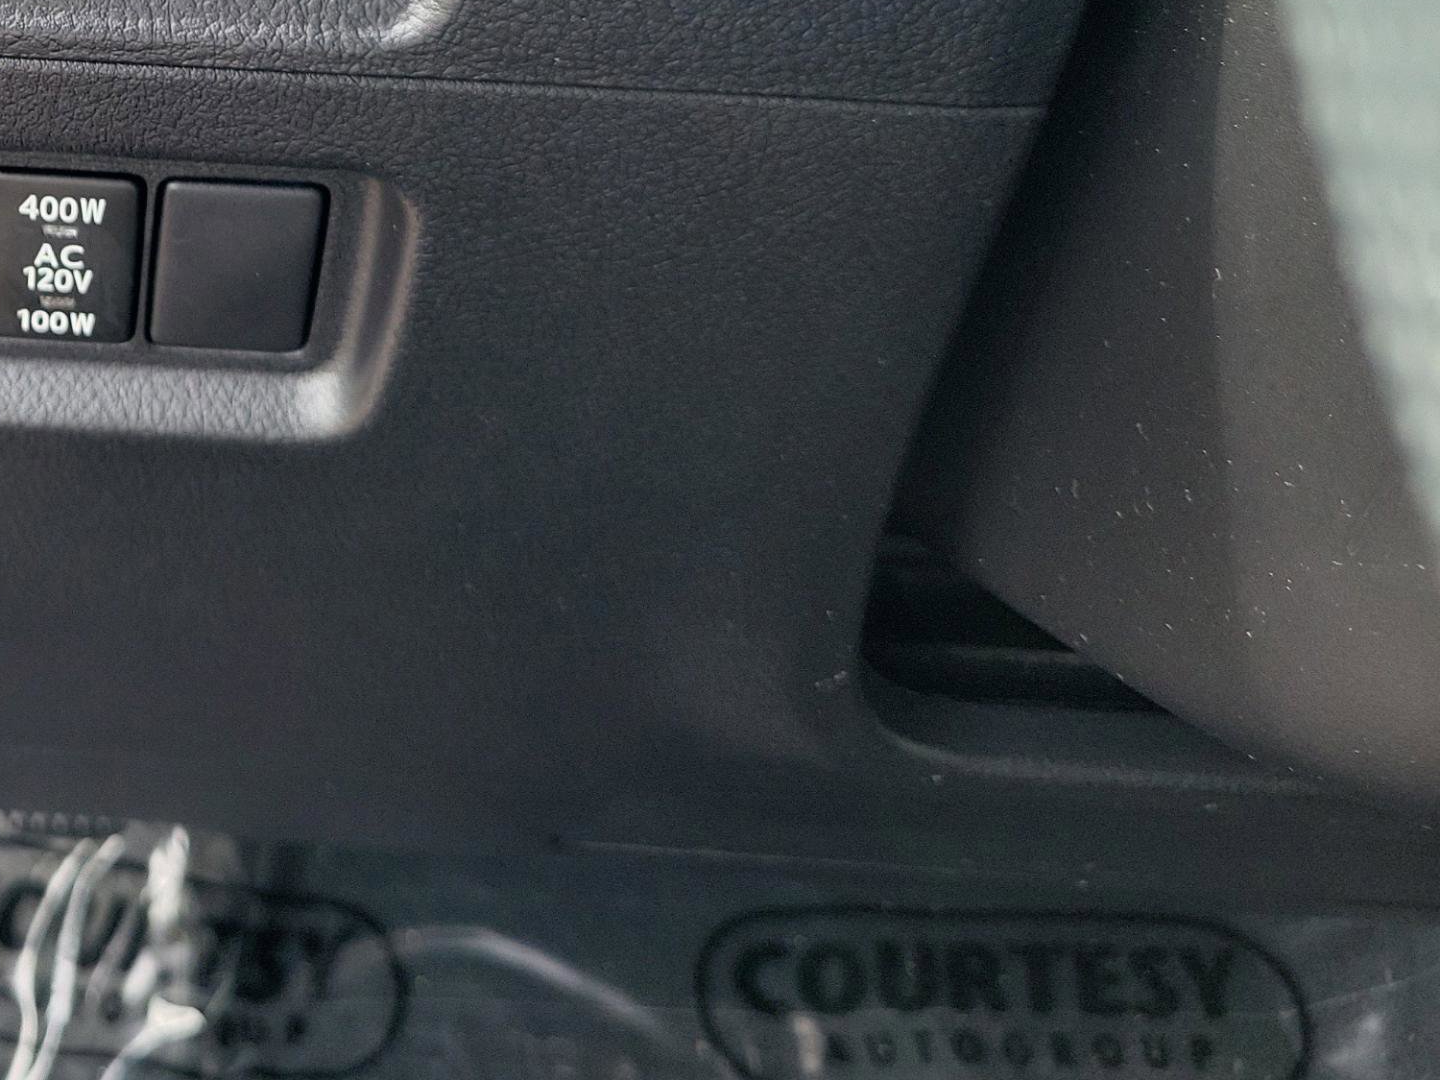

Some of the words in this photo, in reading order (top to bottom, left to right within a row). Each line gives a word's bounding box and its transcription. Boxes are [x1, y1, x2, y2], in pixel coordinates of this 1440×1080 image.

[18, 194, 107, 225] 400W
[33, 242, 86, 270] AC
[22, 265, 94, 295] 120V
[16, 308, 97, 338] 100W
[733, 938, 1238, 1017] COURTESY
